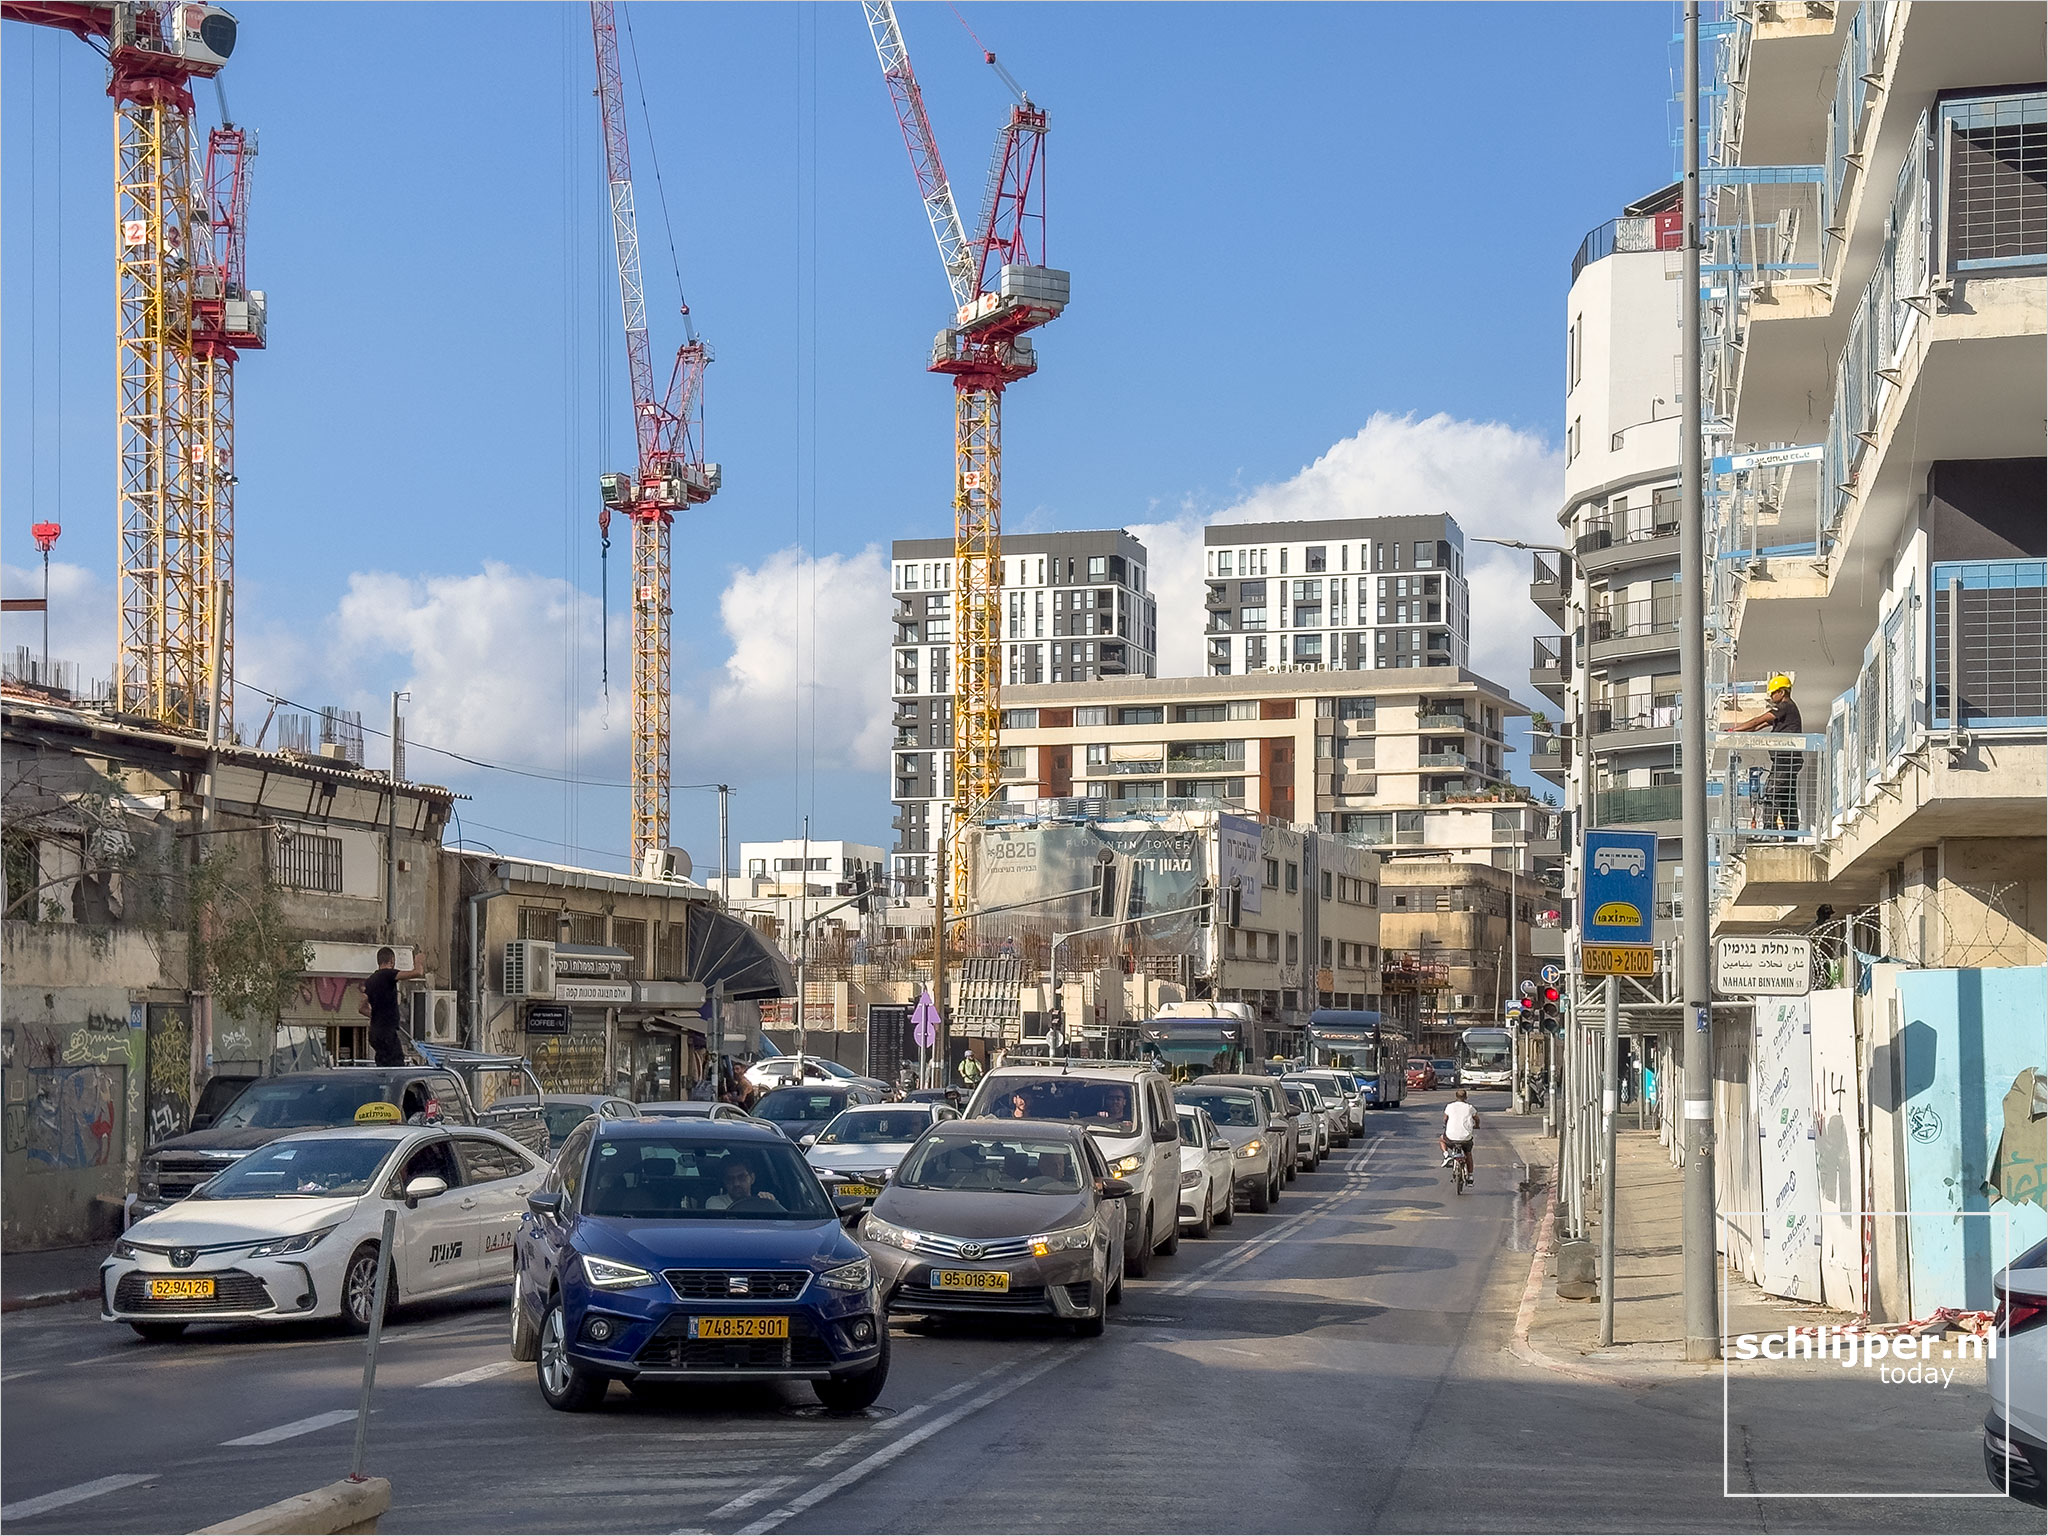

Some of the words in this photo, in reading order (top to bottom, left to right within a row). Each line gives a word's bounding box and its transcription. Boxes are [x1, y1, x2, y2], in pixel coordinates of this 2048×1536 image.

[1065, 839, 1137, 850] FLORNTIN
[1146, 840, 1190, 850] TOWER
[1133, 858, 1156, 872] דיר
[1159, 858, 1192, 875] מגוון
[1723, 942, 1757, 957] בנימין
[1761, 941, 1789, 955] נחלת
[1586, 950, 1613, 971] 05:00
[1624, 951, 1649, 972] 21:00
[1787, 960, 1804, 972] شارع
[1722, 976, 1757, 988] NAHALAT
[1758, 977, 1794, 988] BINYAMIN
[565, 987, 579, 1000] קפה
[131, 1009, 141, 1024] 68
[1773, 1004, 1796, 1046] D-BOND
[1777, 1108, 1799, 1148] D-BOND
[1781, 1214, 1807, 1251] D-BOND
